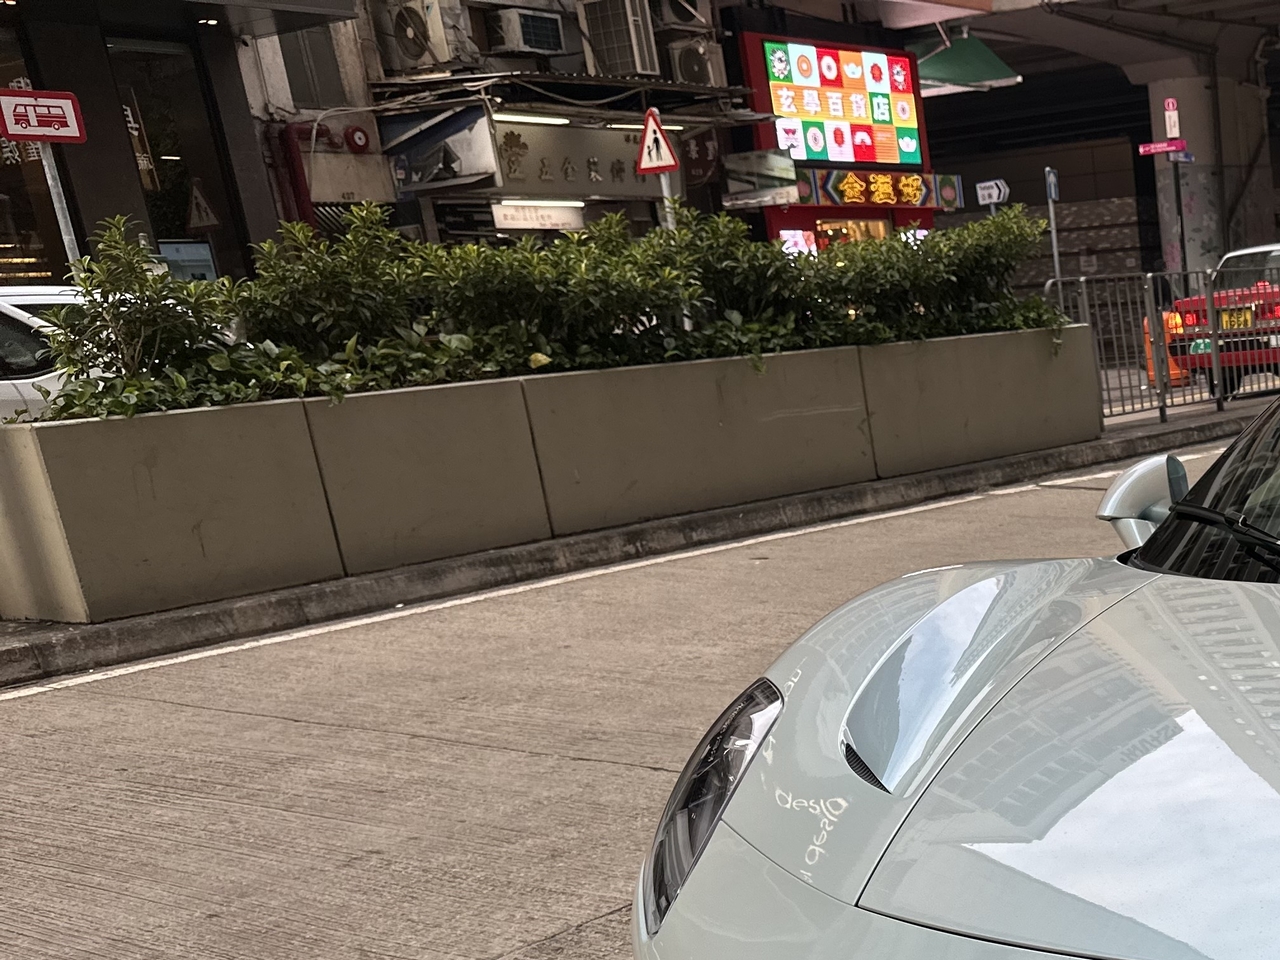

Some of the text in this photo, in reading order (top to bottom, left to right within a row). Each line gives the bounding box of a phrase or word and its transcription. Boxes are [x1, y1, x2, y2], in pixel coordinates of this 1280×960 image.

[777, 87, 890, 121] 玄學百貨店
